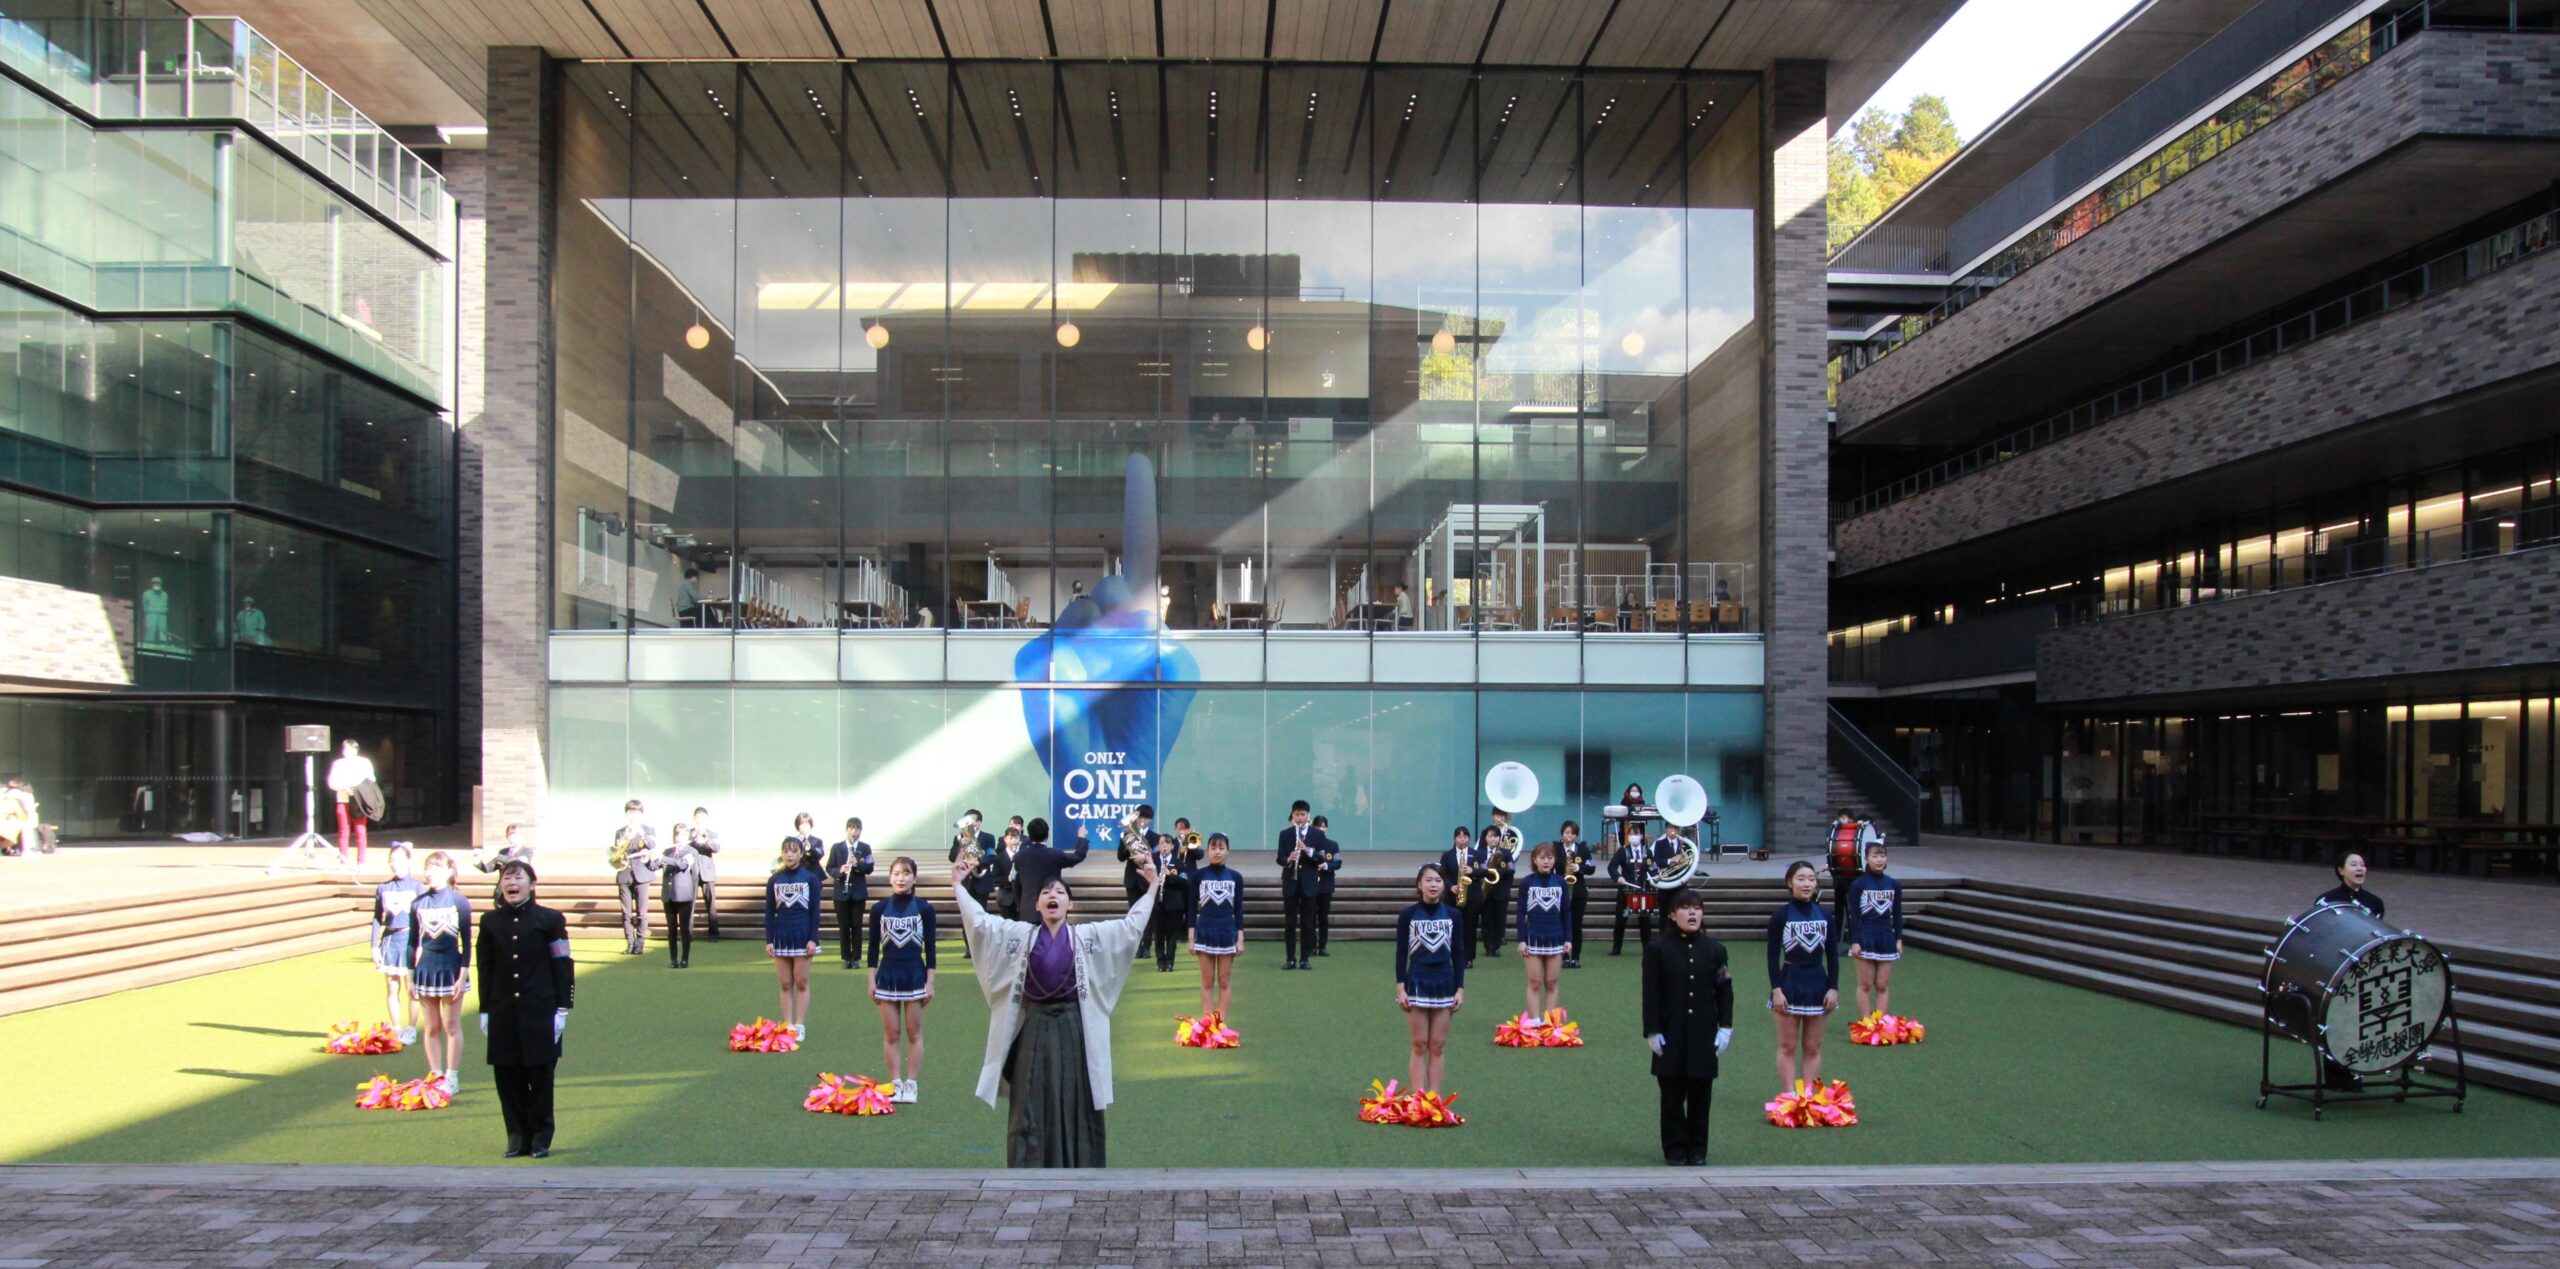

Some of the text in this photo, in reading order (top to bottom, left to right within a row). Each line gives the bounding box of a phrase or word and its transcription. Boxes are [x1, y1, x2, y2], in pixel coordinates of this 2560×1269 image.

[1084, 752, 1126, 765] ONLY
[1063, 768, 1147, 800] ONE
[1065, 804, 1142, 819] CAMPU
[776, 884, 803, 896] KYOSAN
[1204, 882, 1233, 893] KYOSAN
[1532, 886, 1560, 899] KYOSAN
[1866, 890, 1893, 901] KYOSAN
[882, 917, 918, 932] KYOSAN
[1413, 920, 1451, 936] KYOSAN
[1790, 921, 1826, 938] KYOSAN
